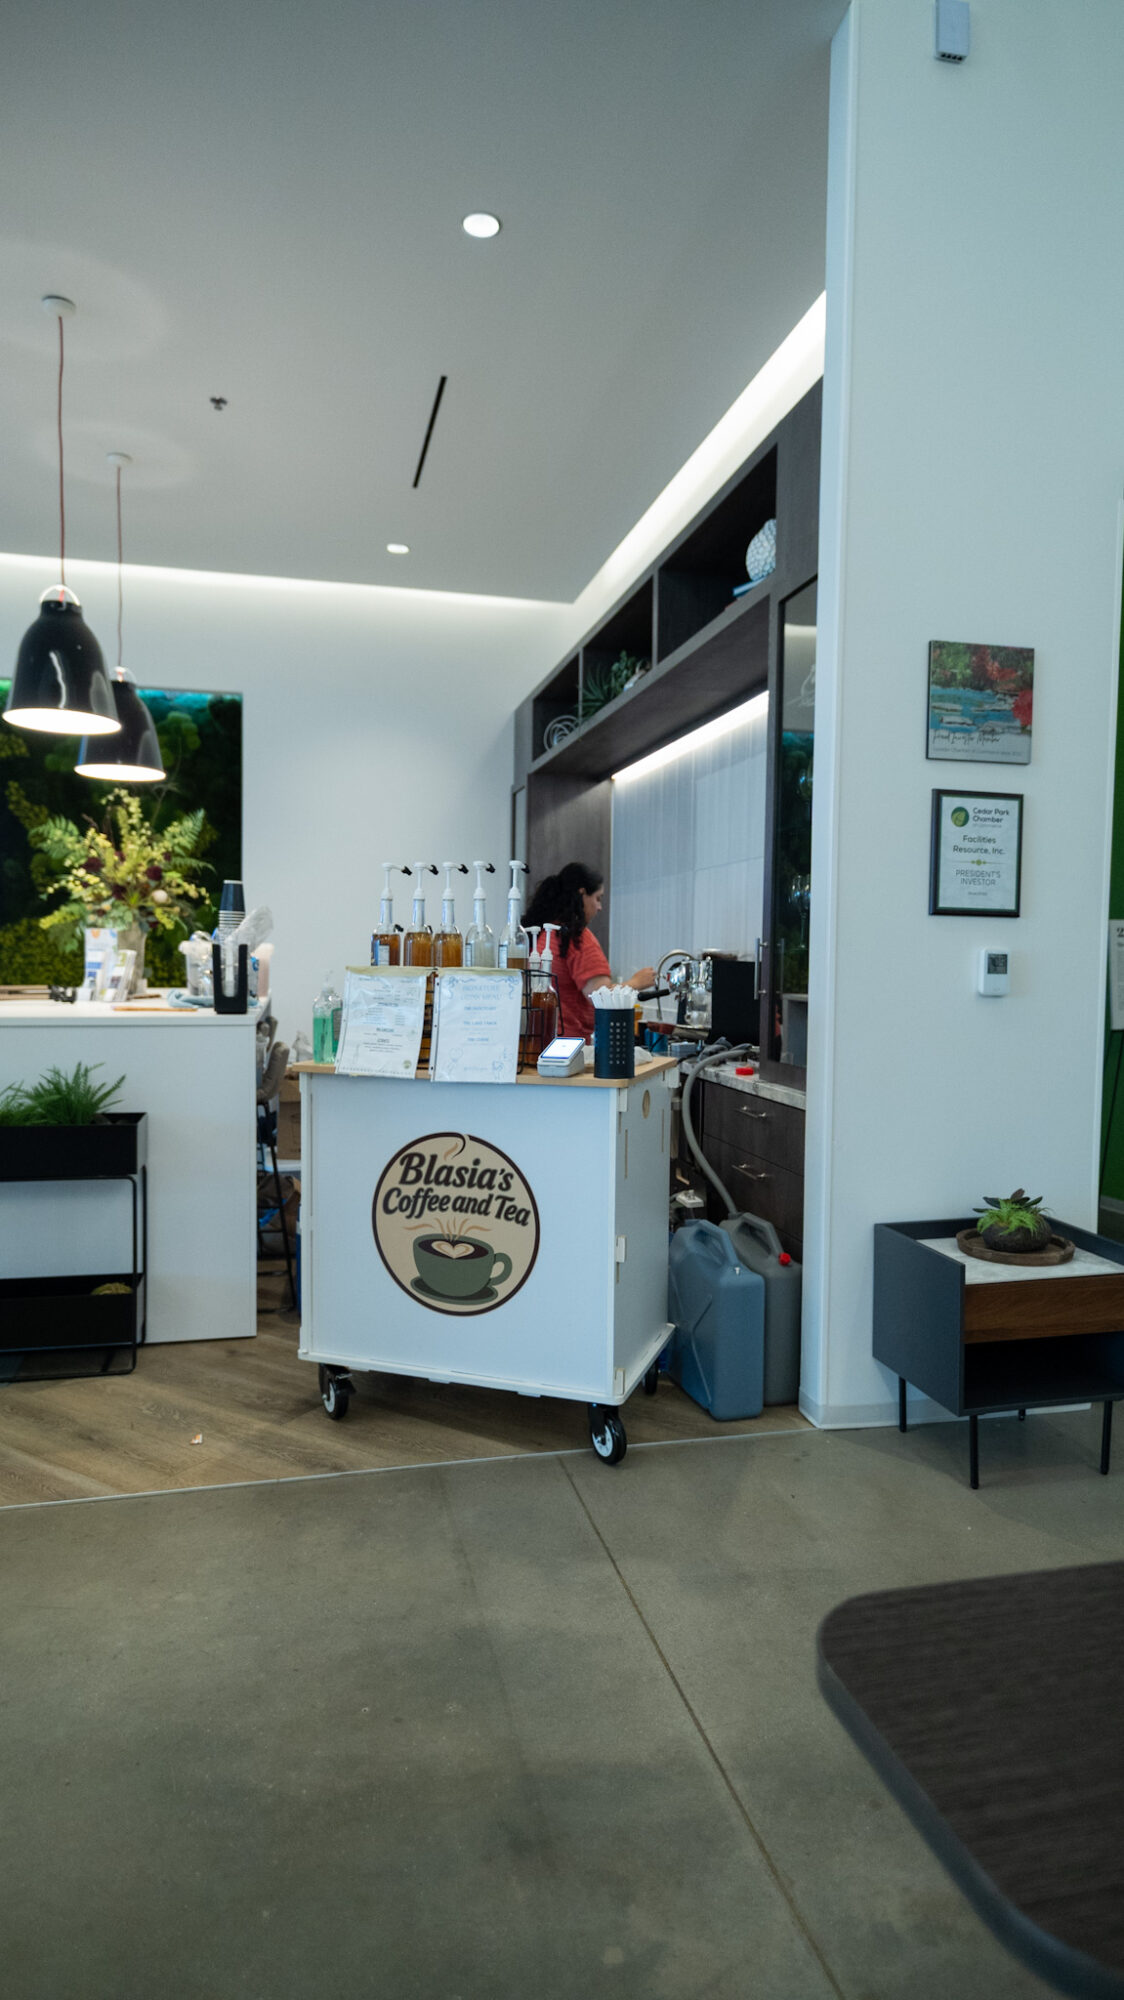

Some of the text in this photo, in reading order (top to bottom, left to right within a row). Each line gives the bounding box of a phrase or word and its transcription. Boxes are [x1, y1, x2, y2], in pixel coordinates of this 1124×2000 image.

[972, 807, 1010, 816] Cedar Park
[972, 815, 1004, 823] Chamber
[962, 834, 997, 844] Facilities
[953, 844, 1007, 855] Resource, Inc.
[955, 869, 1001, 879] PRESIDENT'S
[960, 877, 996, 887] INVESTOR
[398, 1152, 514, 1192] Blasia's
[382, 1187, 532, 1227] Coffee and Tea
